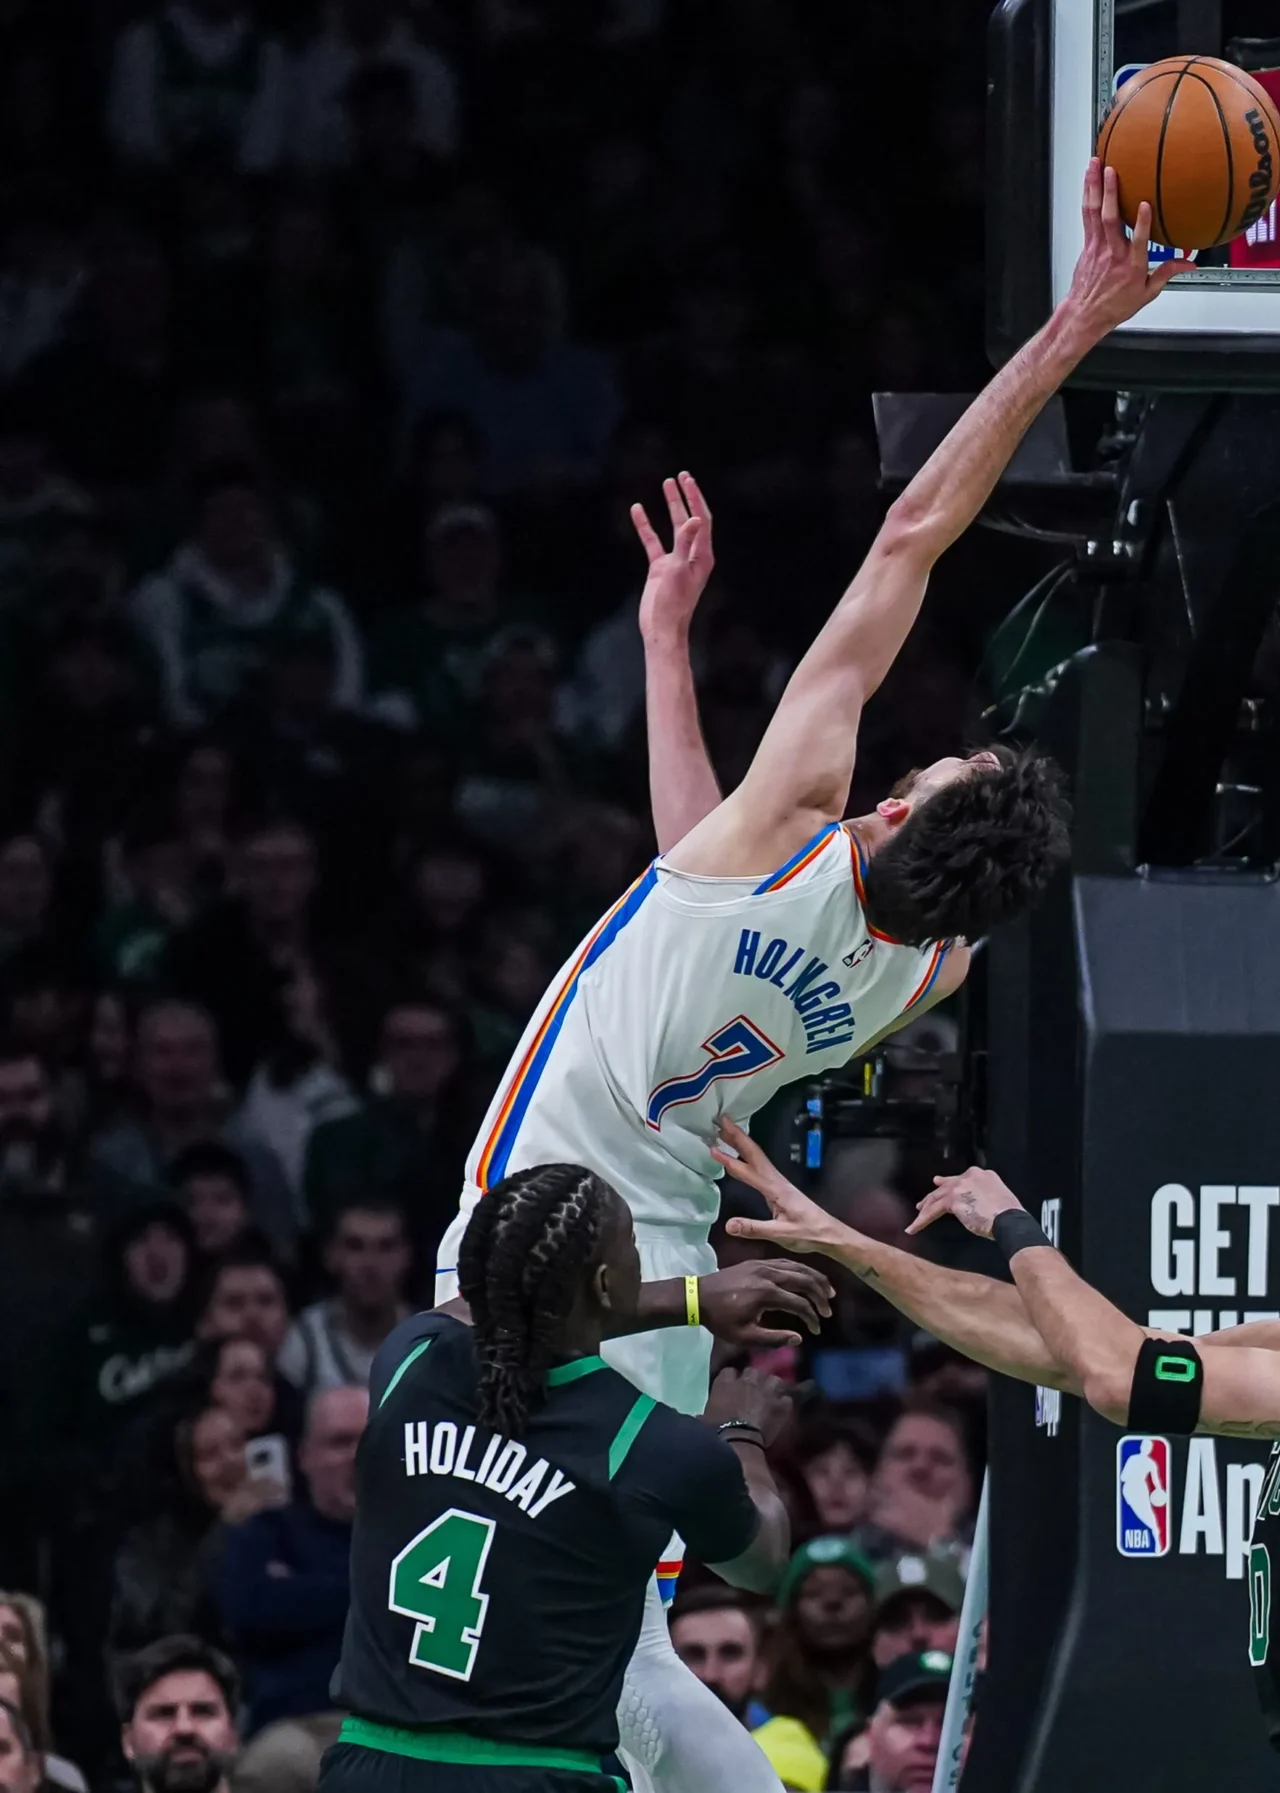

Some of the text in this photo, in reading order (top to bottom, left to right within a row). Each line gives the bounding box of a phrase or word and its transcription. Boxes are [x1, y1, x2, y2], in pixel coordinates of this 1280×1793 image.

[1236, 108, 1272, 232] Wilson
[733, 928, 856, 1055] HOLMGREN
[646, 1014, 786, 1133] 7
[403, 1421, 577, 1520] HOLIDAY
[1179, 1437, 1267, 1580] Ap
[388, 1507, 497, 1683] 4
[1124, 1529, 1152, 1549] NBA
[1248, 1542, 1271, 1667] 0
